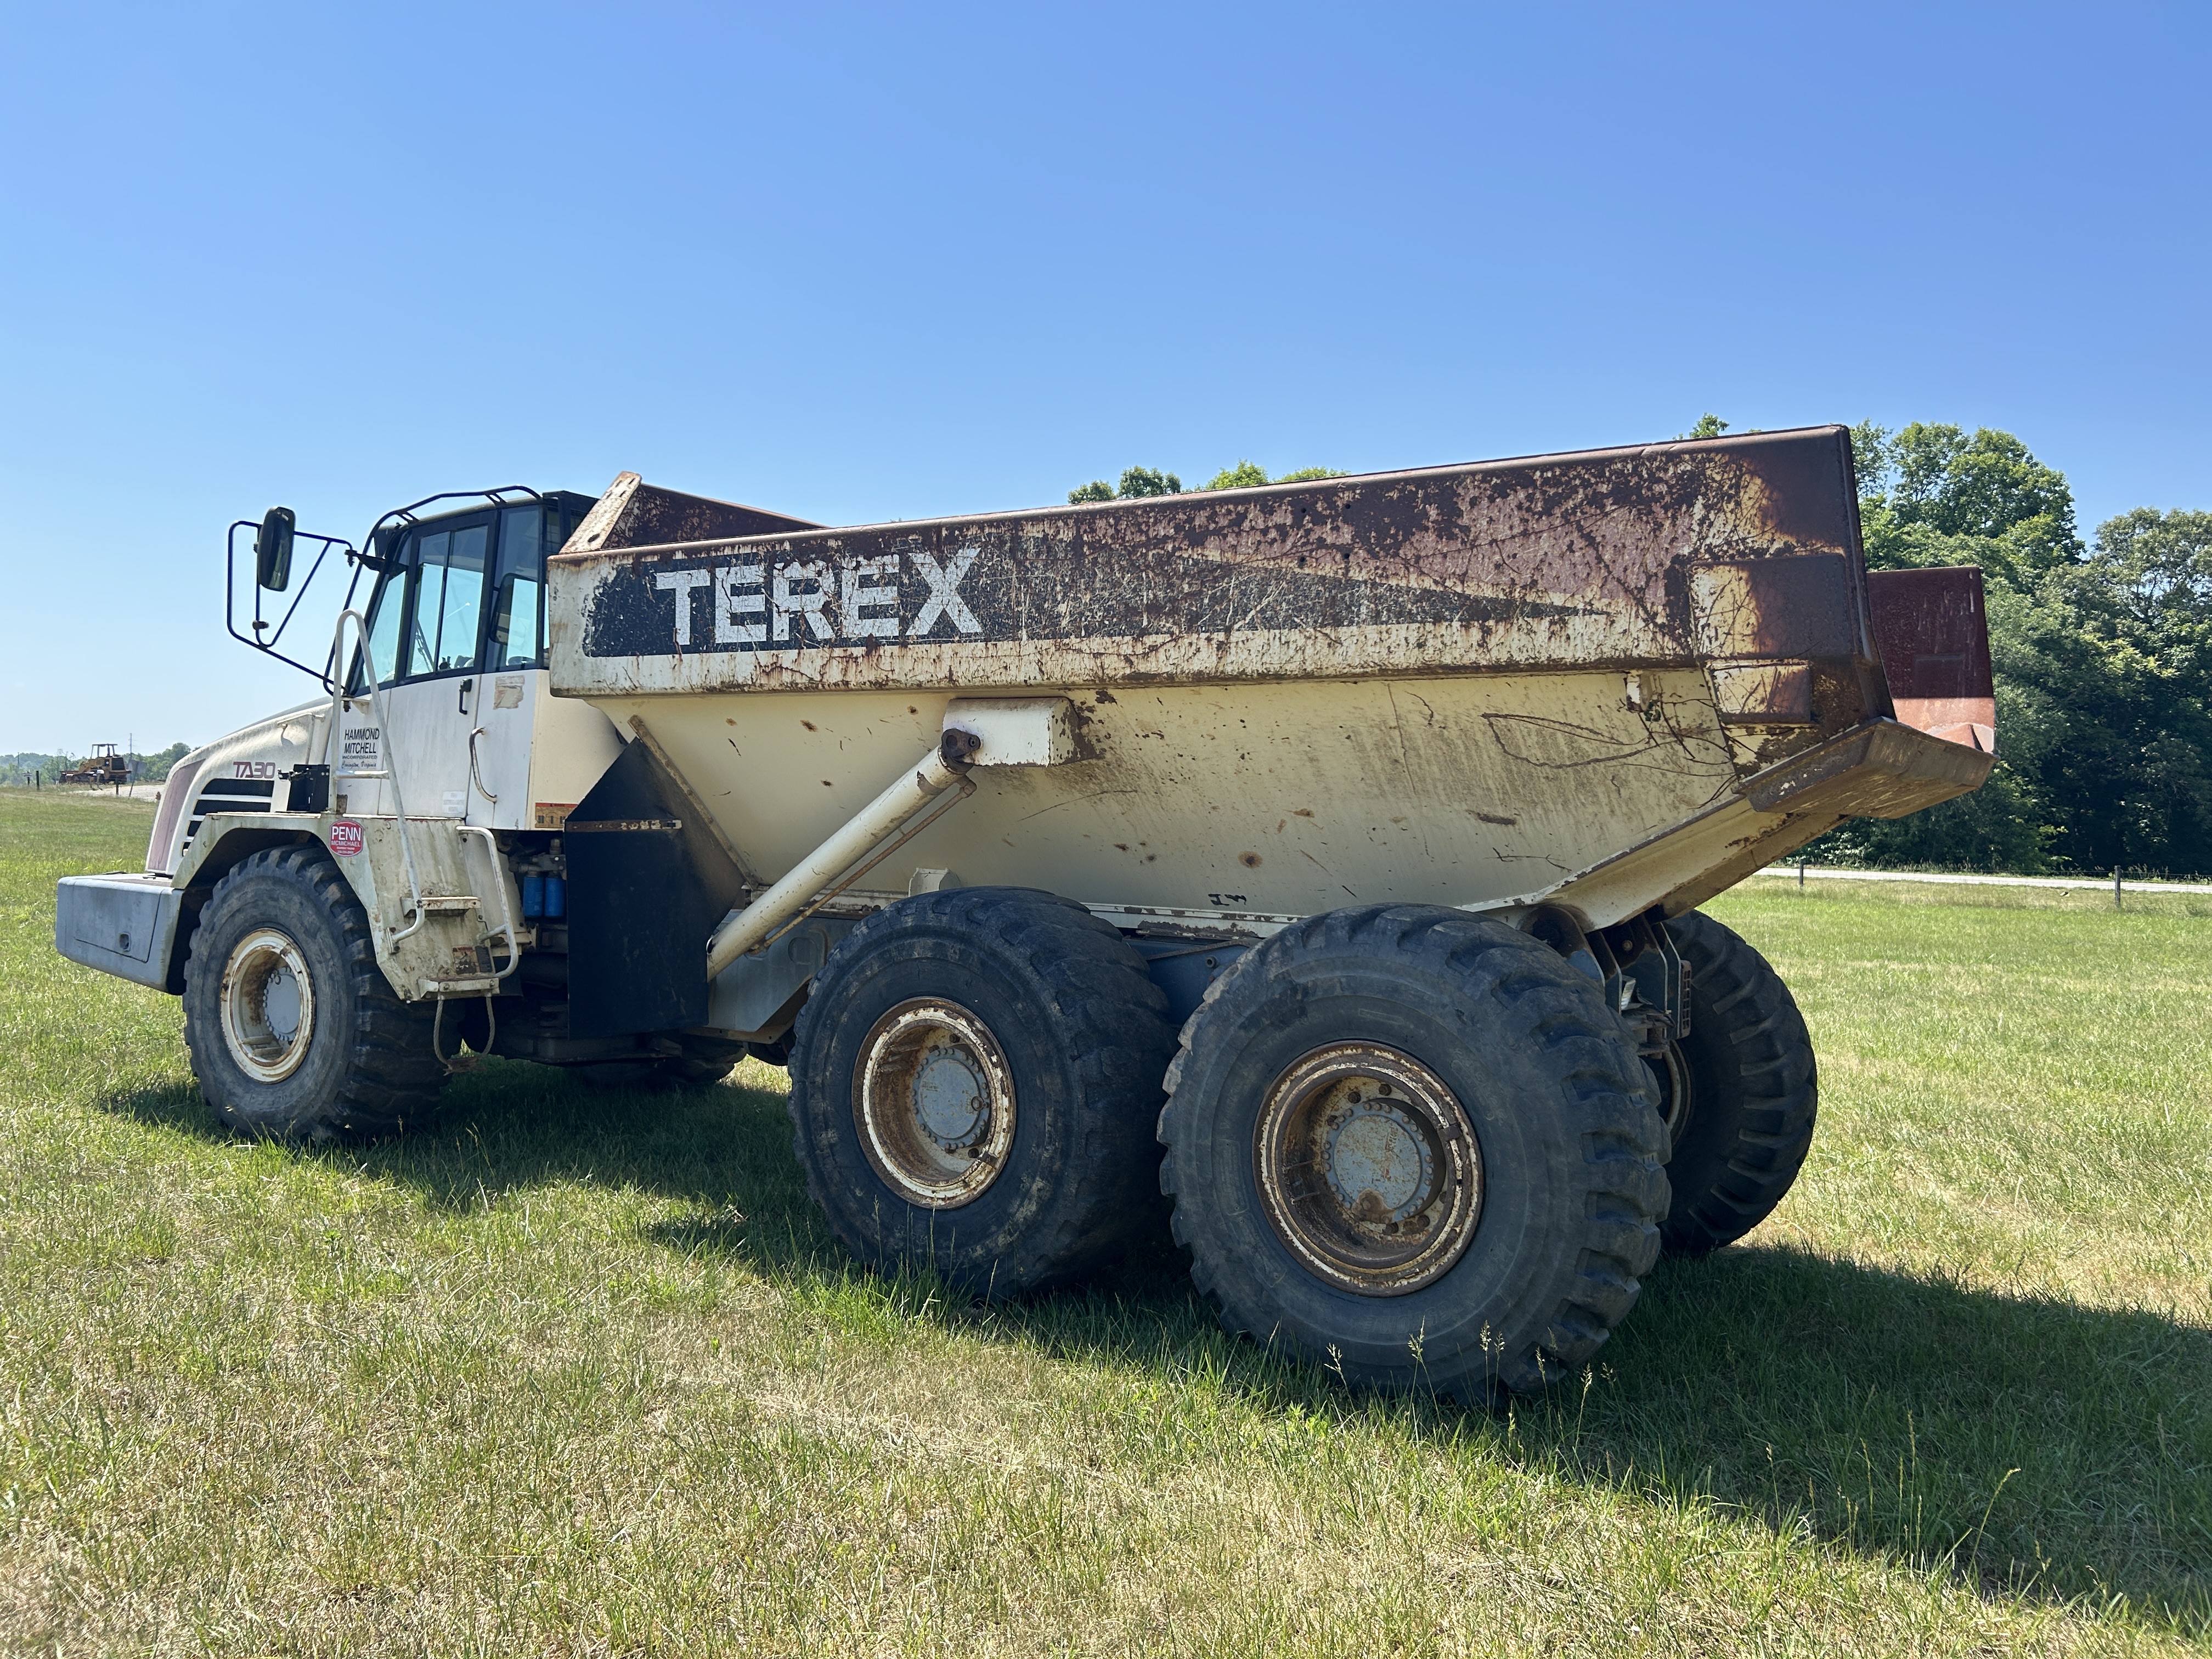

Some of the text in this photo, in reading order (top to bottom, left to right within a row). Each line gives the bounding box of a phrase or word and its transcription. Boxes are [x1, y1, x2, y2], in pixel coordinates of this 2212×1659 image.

[656, 548, 982, 646] TEREX
[345, 728, 380, 740] HAMMOND
[344, 742, 376, 754] MITCHELL
[233, 761, 275, 778] TA30
[332, 826, 361, 841] PENN
